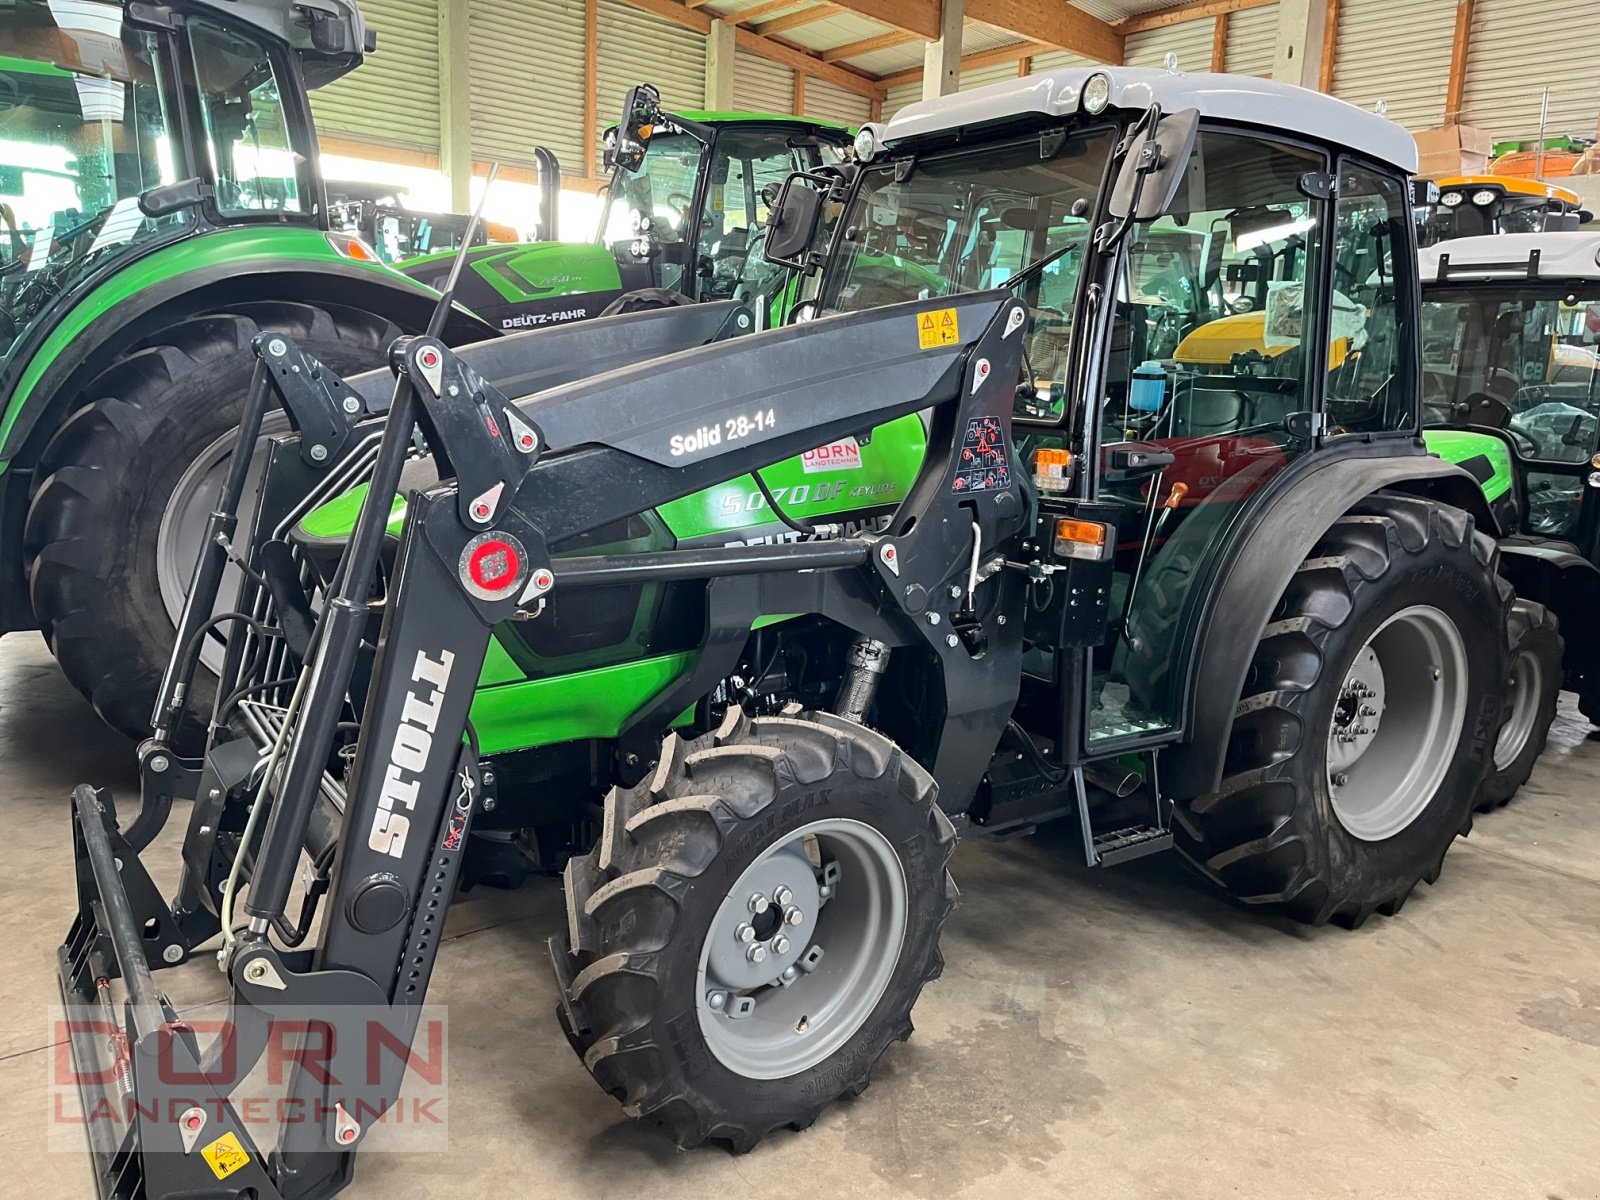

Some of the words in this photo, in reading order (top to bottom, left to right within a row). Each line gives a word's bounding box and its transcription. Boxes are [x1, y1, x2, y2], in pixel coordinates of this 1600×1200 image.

[502, 308, 587, 329] DEUTZ-FAHR
[670, 423, 721, 456] Solid
[725, 408, 776, 441] 28-14
[804, 457, 860, 469] LANDTECHNIK
[720, 484, 810, 517] 5070
[813, 480, 848, 503] DF
[848, 482, 897, 498] KEYLINE
[368, 649, 455, 859] STOLL
